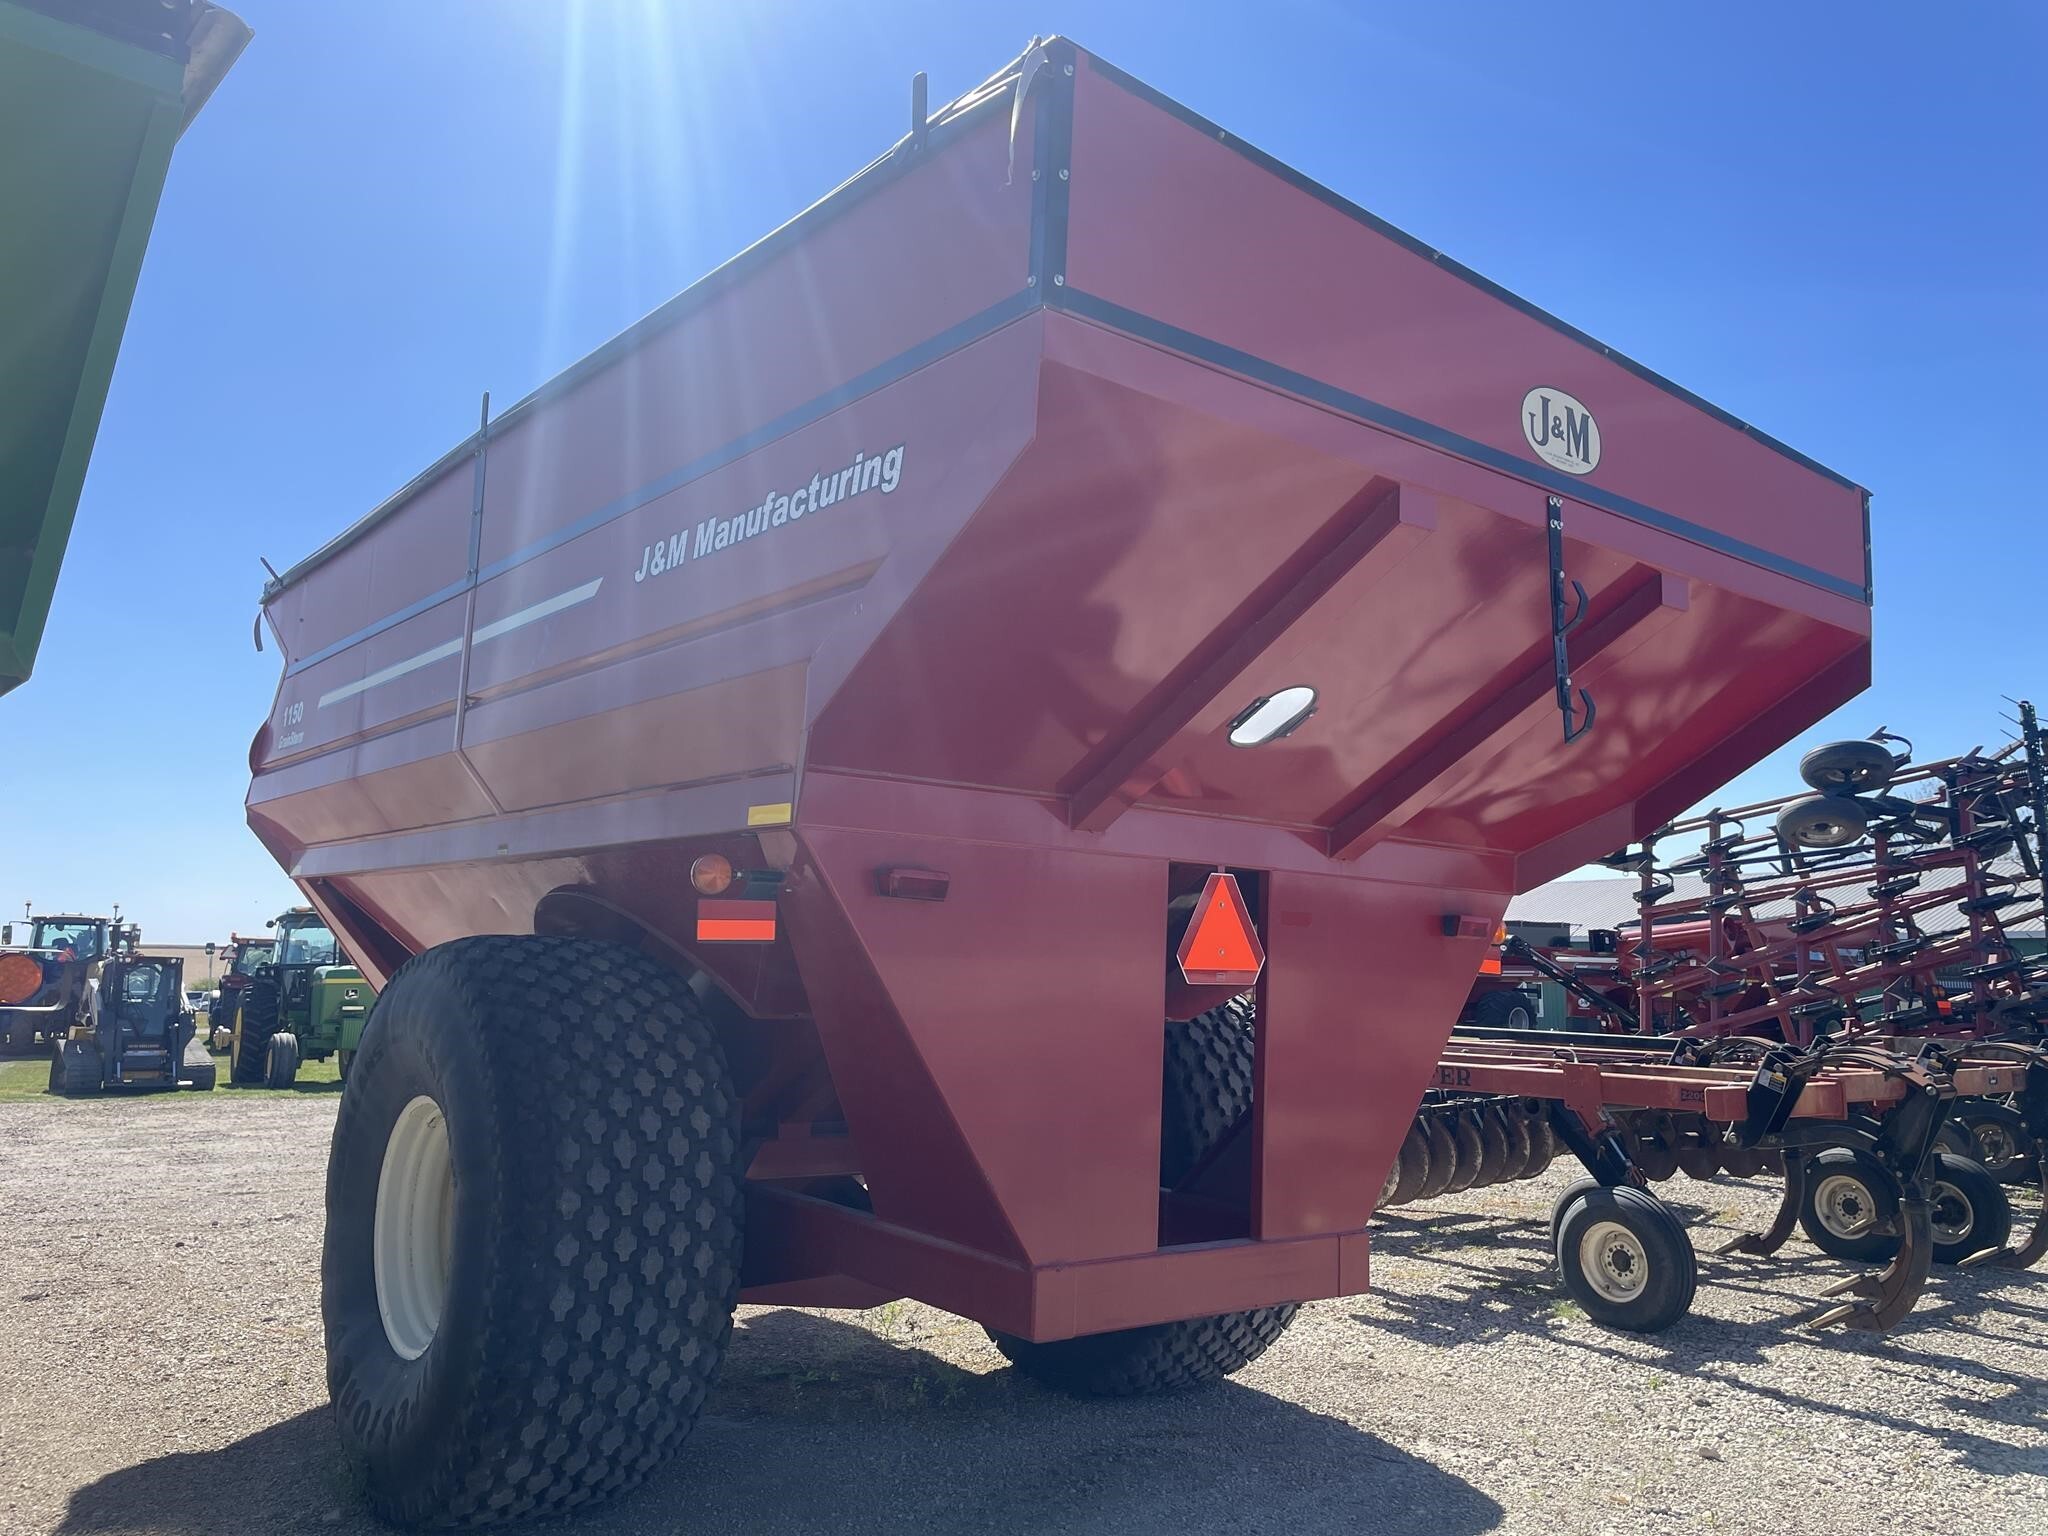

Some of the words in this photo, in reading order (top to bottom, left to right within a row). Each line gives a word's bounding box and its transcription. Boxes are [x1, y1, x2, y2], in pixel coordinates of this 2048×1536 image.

[1528, 395, 1592, 465] J&M
[634, 529, 689, 583] J&M
[693, 446, 905, 560] Manufacturing
[283, 701, 304, 728] 1150
